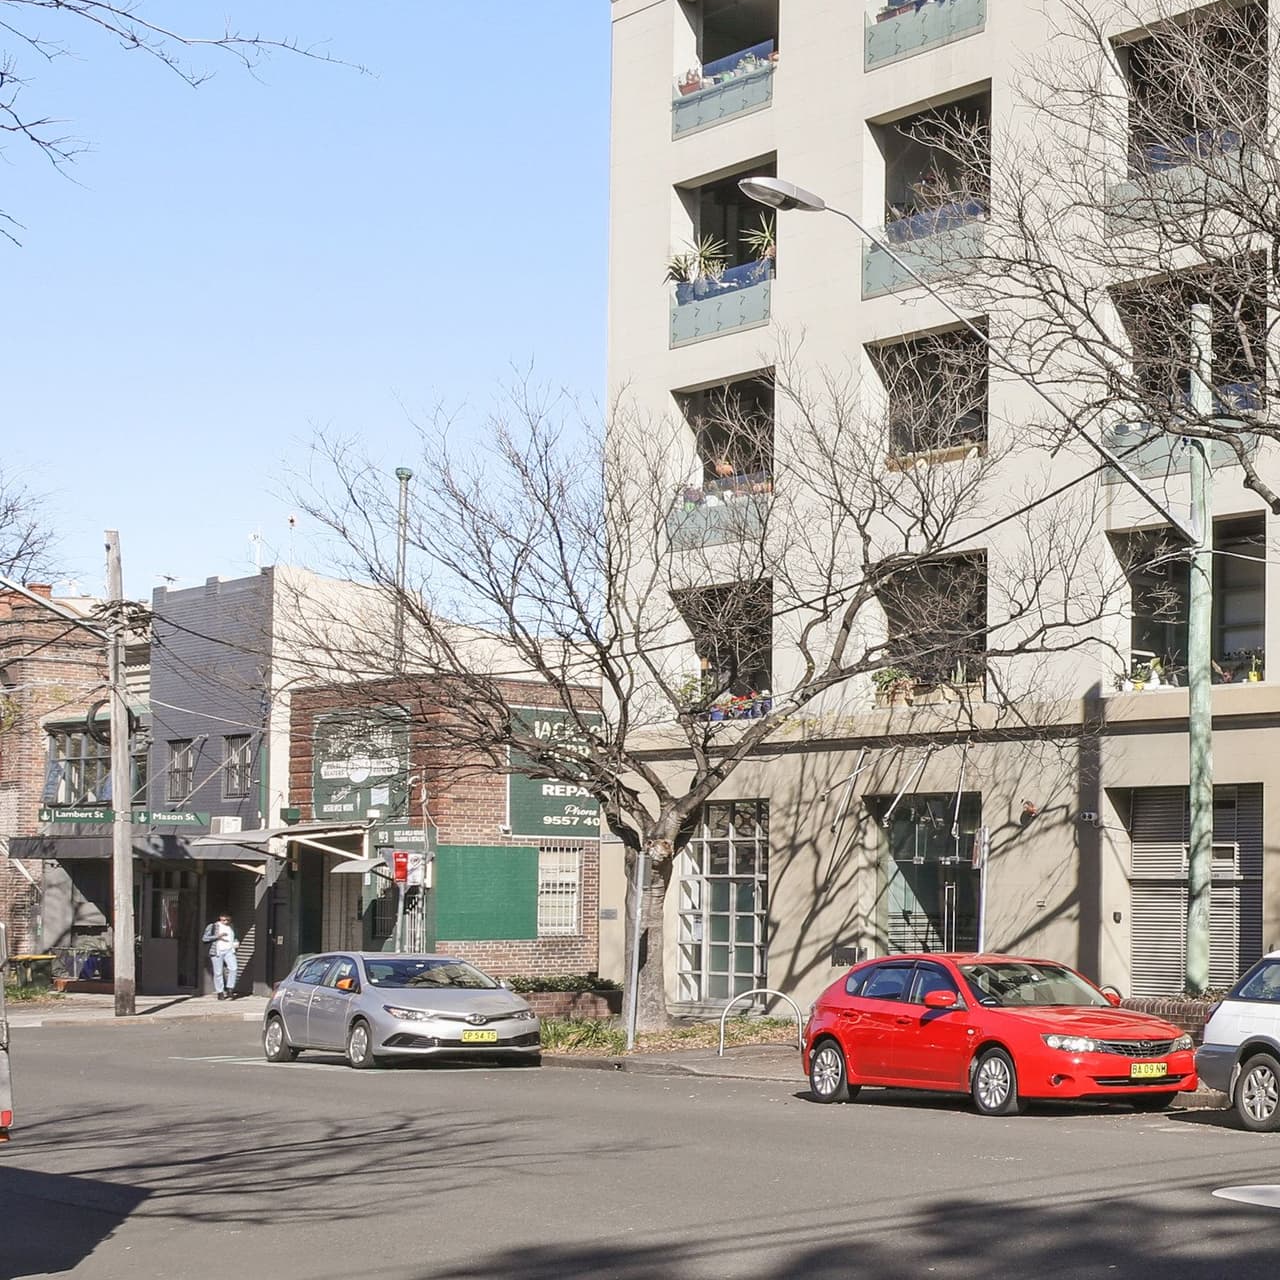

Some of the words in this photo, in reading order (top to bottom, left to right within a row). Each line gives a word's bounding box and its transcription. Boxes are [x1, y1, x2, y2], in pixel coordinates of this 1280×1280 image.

[542, 784, 595, 797] REPA
[564, 804, 597, 816] Phone
[55, 811, 92, 819] Lambert
[94, 811, 104, 819] St
[152, 812, 183, 820] Mason
[186, 813, 195, 821] St
[543, 816, 580, 825] 9557
